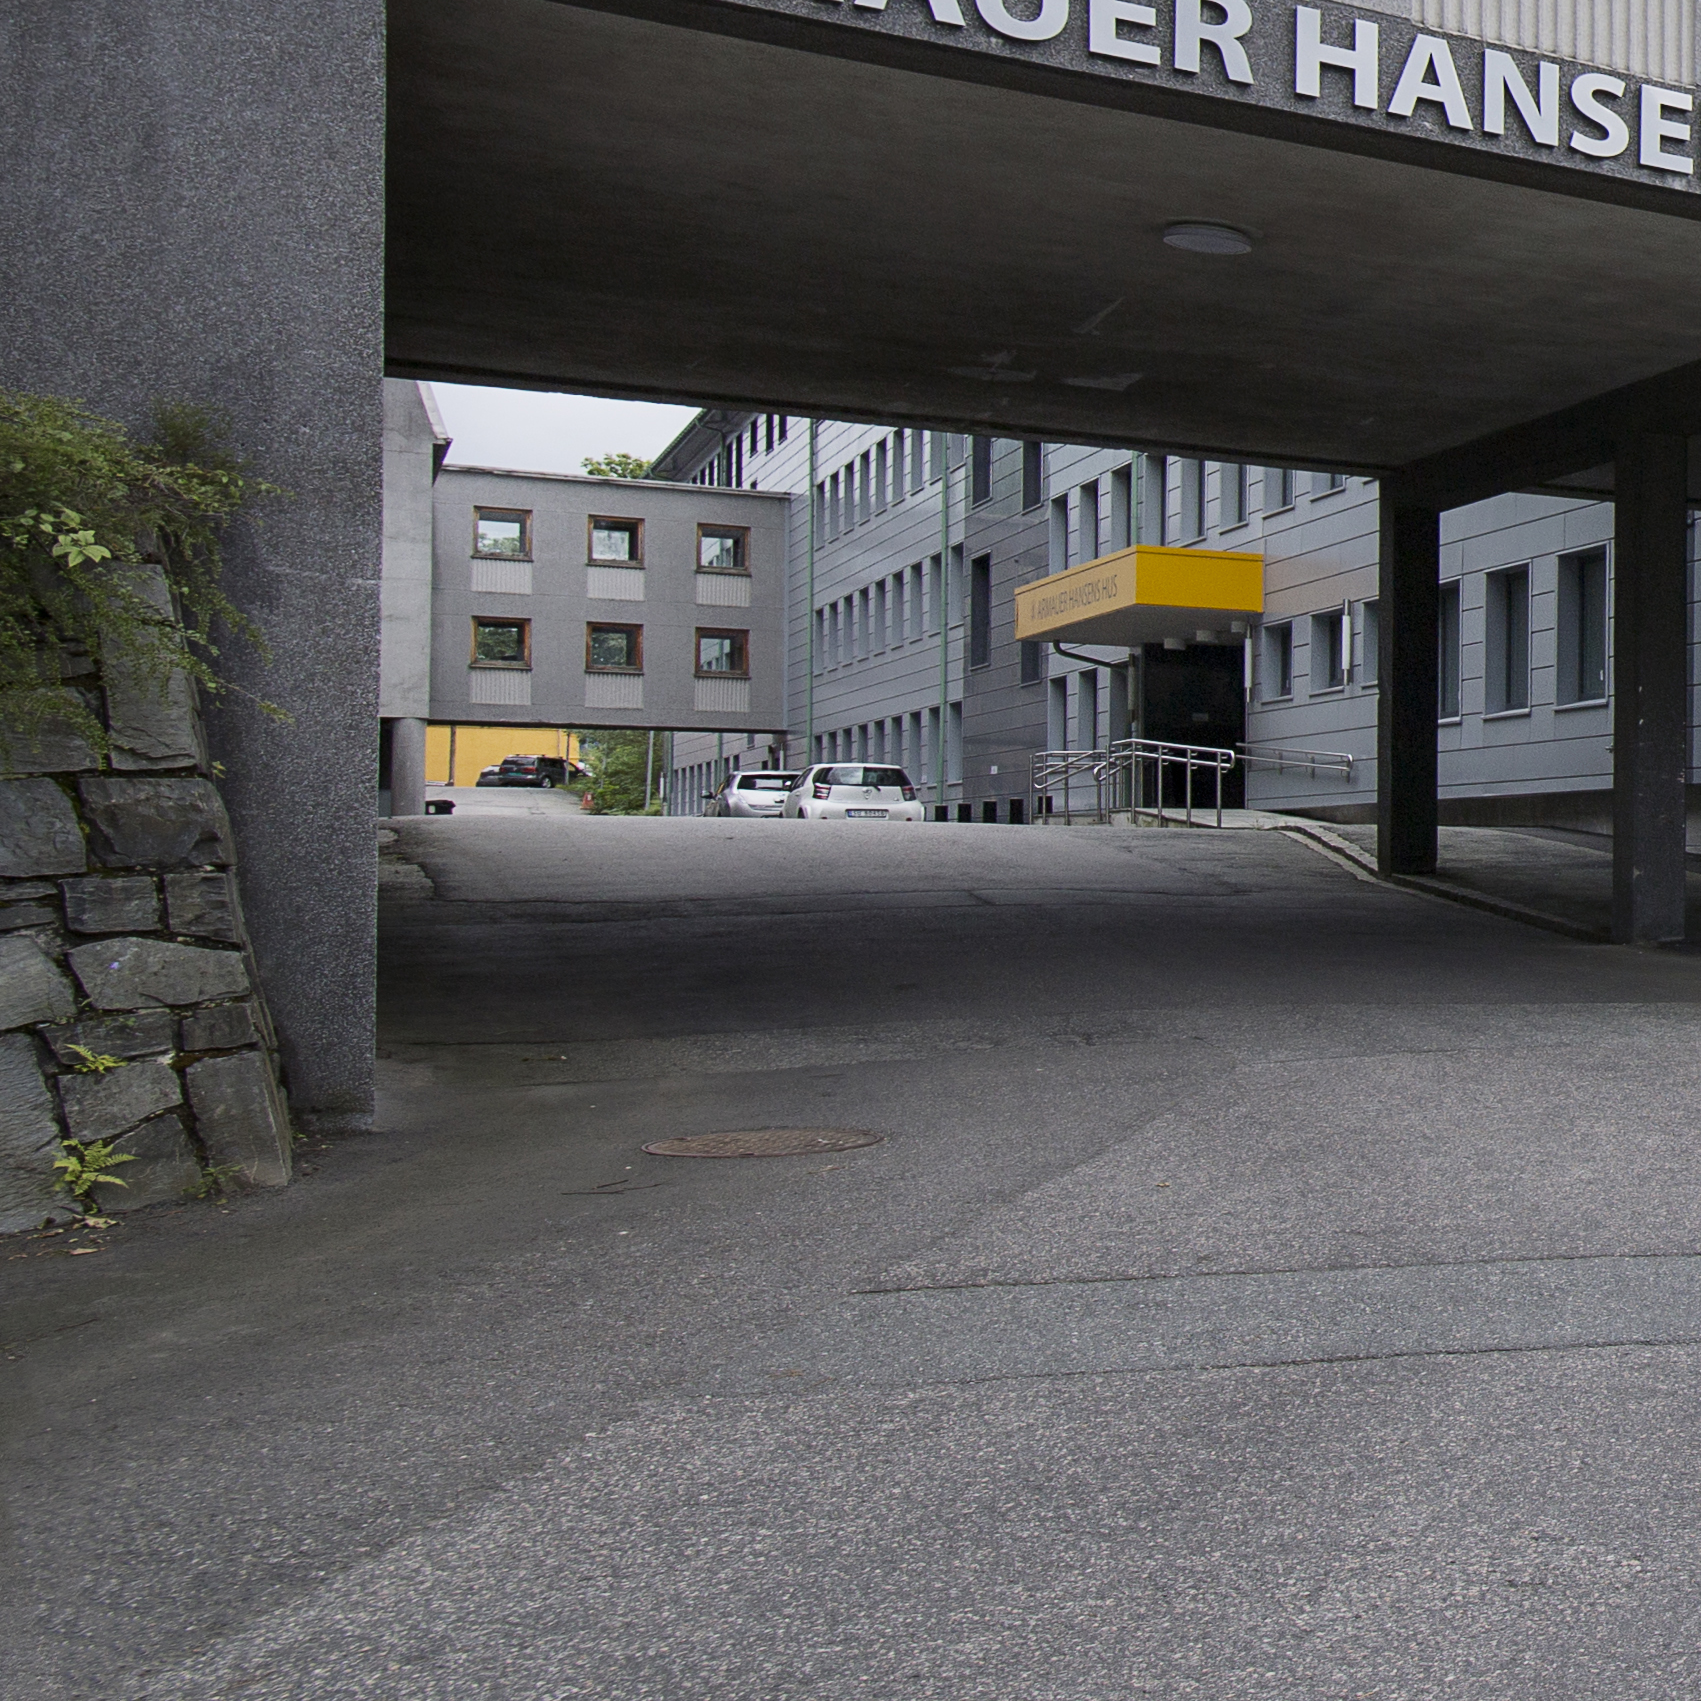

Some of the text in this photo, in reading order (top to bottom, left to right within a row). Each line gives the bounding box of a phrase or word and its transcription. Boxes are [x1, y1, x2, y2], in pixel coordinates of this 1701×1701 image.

[1038, 574, 1118, 620] ARMAUER HANSENS HUS
